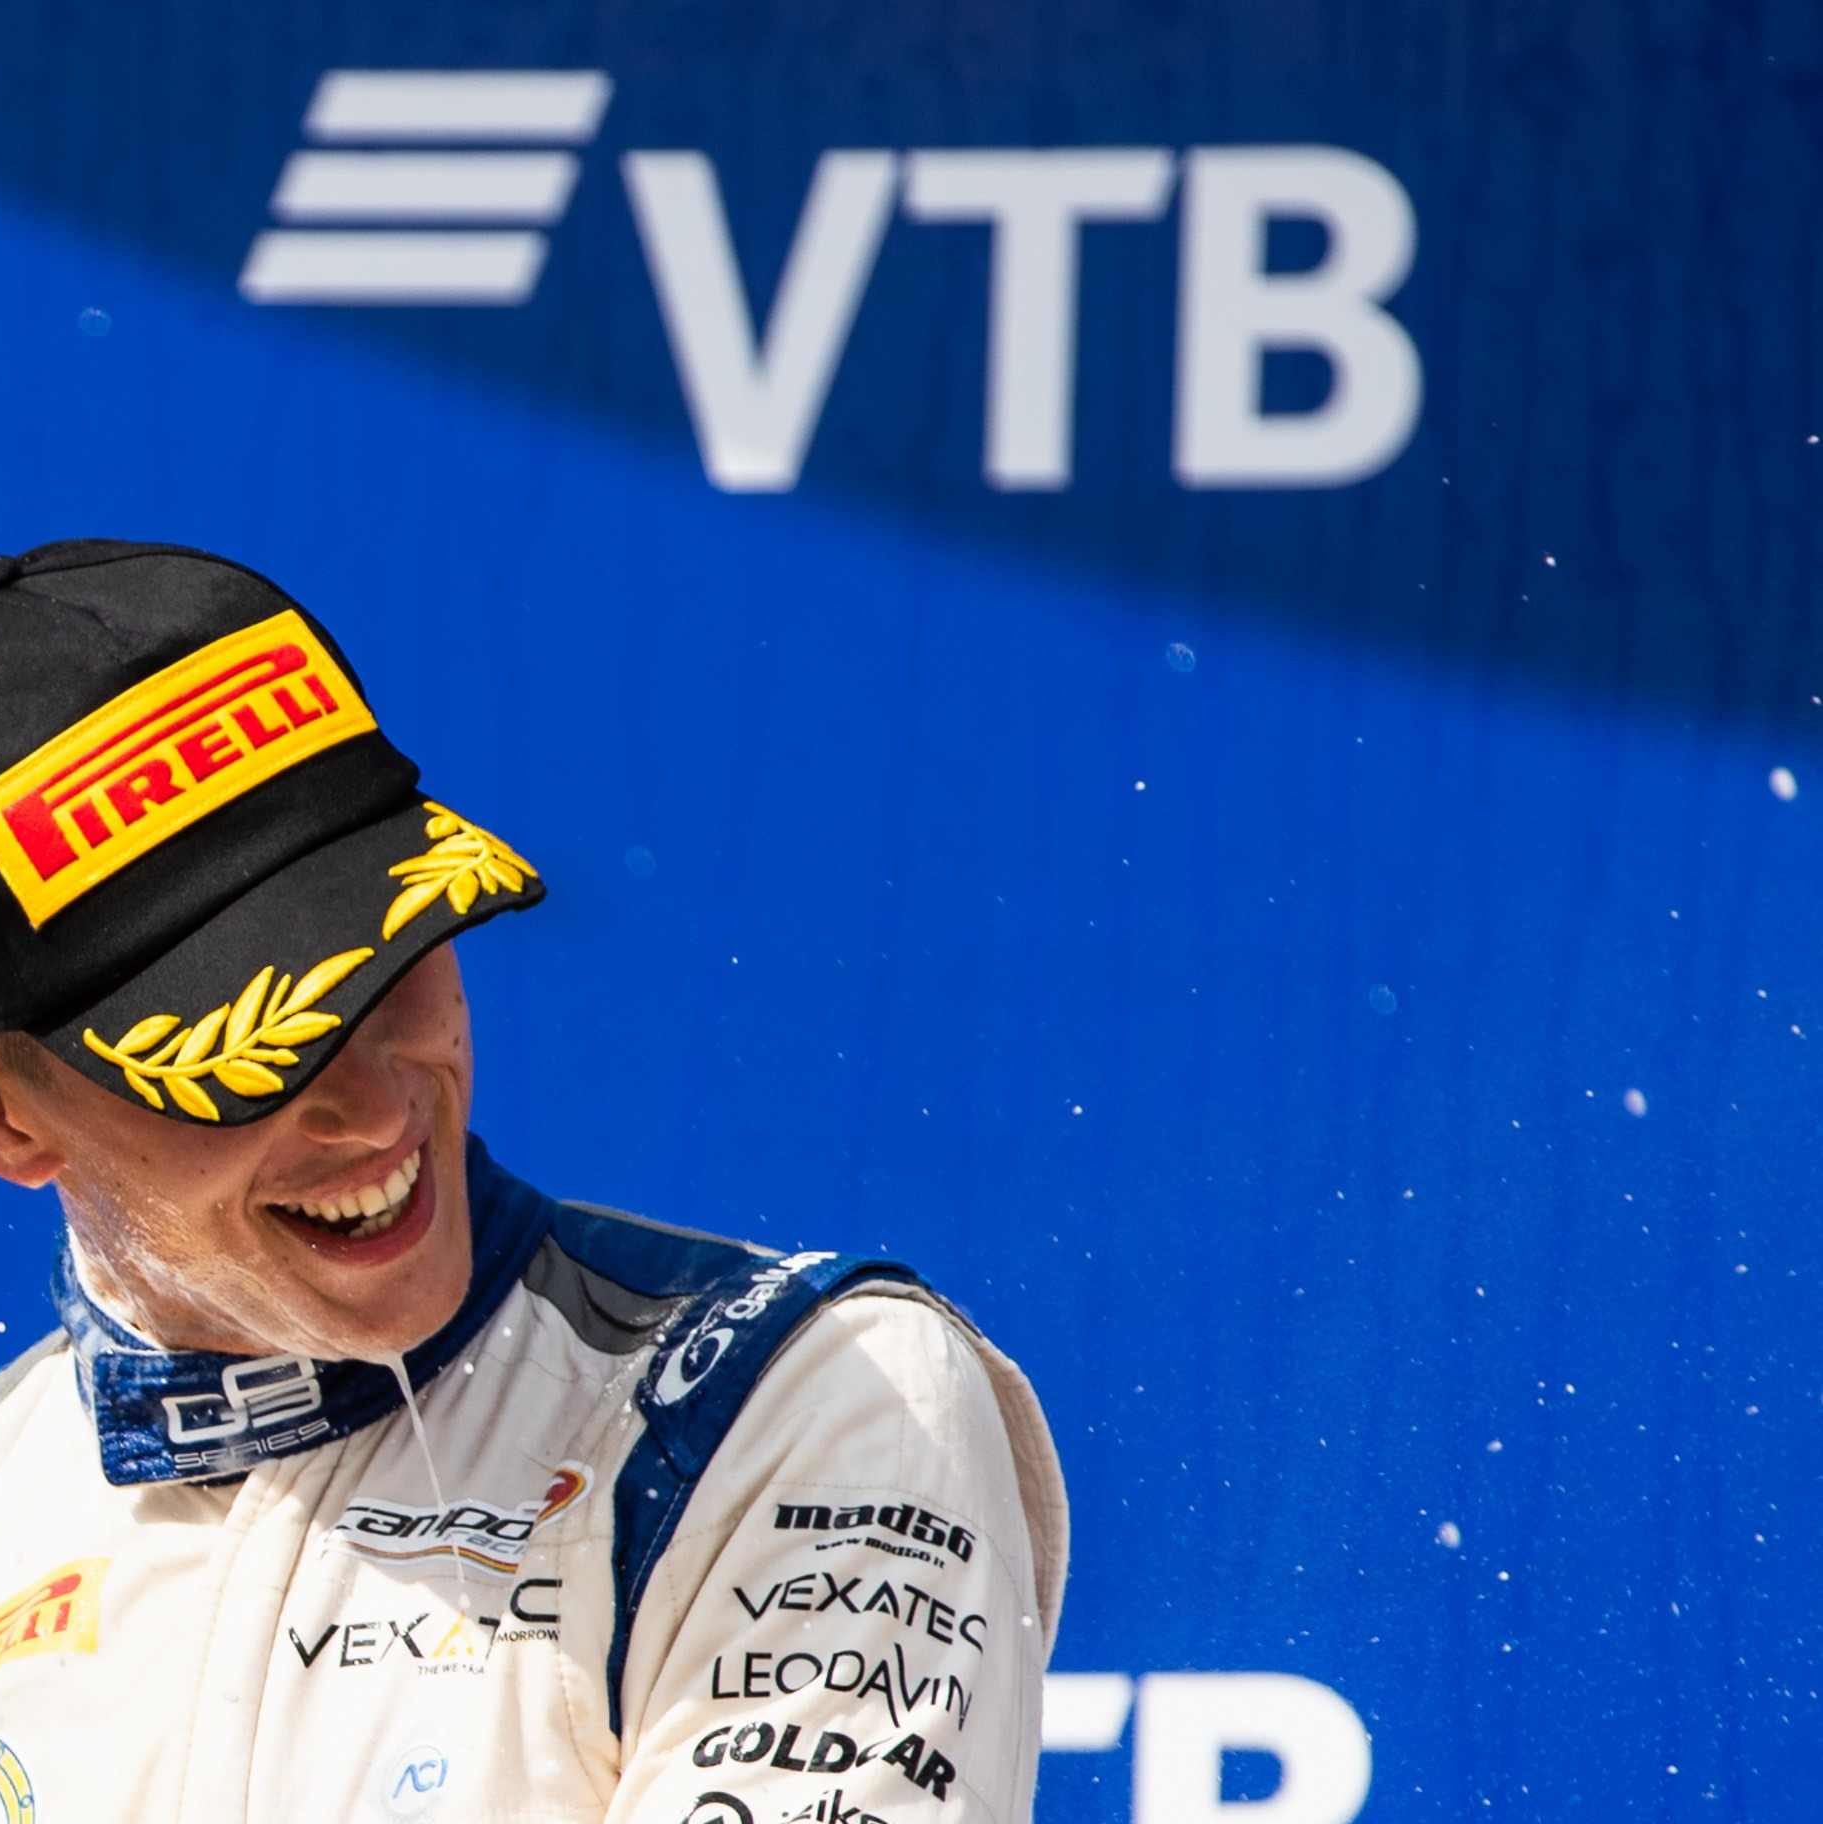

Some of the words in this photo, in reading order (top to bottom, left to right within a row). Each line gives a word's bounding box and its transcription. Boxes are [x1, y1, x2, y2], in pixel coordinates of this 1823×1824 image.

[620, 142, 1426, 494] VTB
[1, 643, 338, 881] PIRELLI
[174, 1417, 330, 1470] SERIES
[774, 1503, 976, 1563] mad56
[288, 1579, 563, 1668] VEXATC
[732, 1571, 988, 1656] VEXATEC
